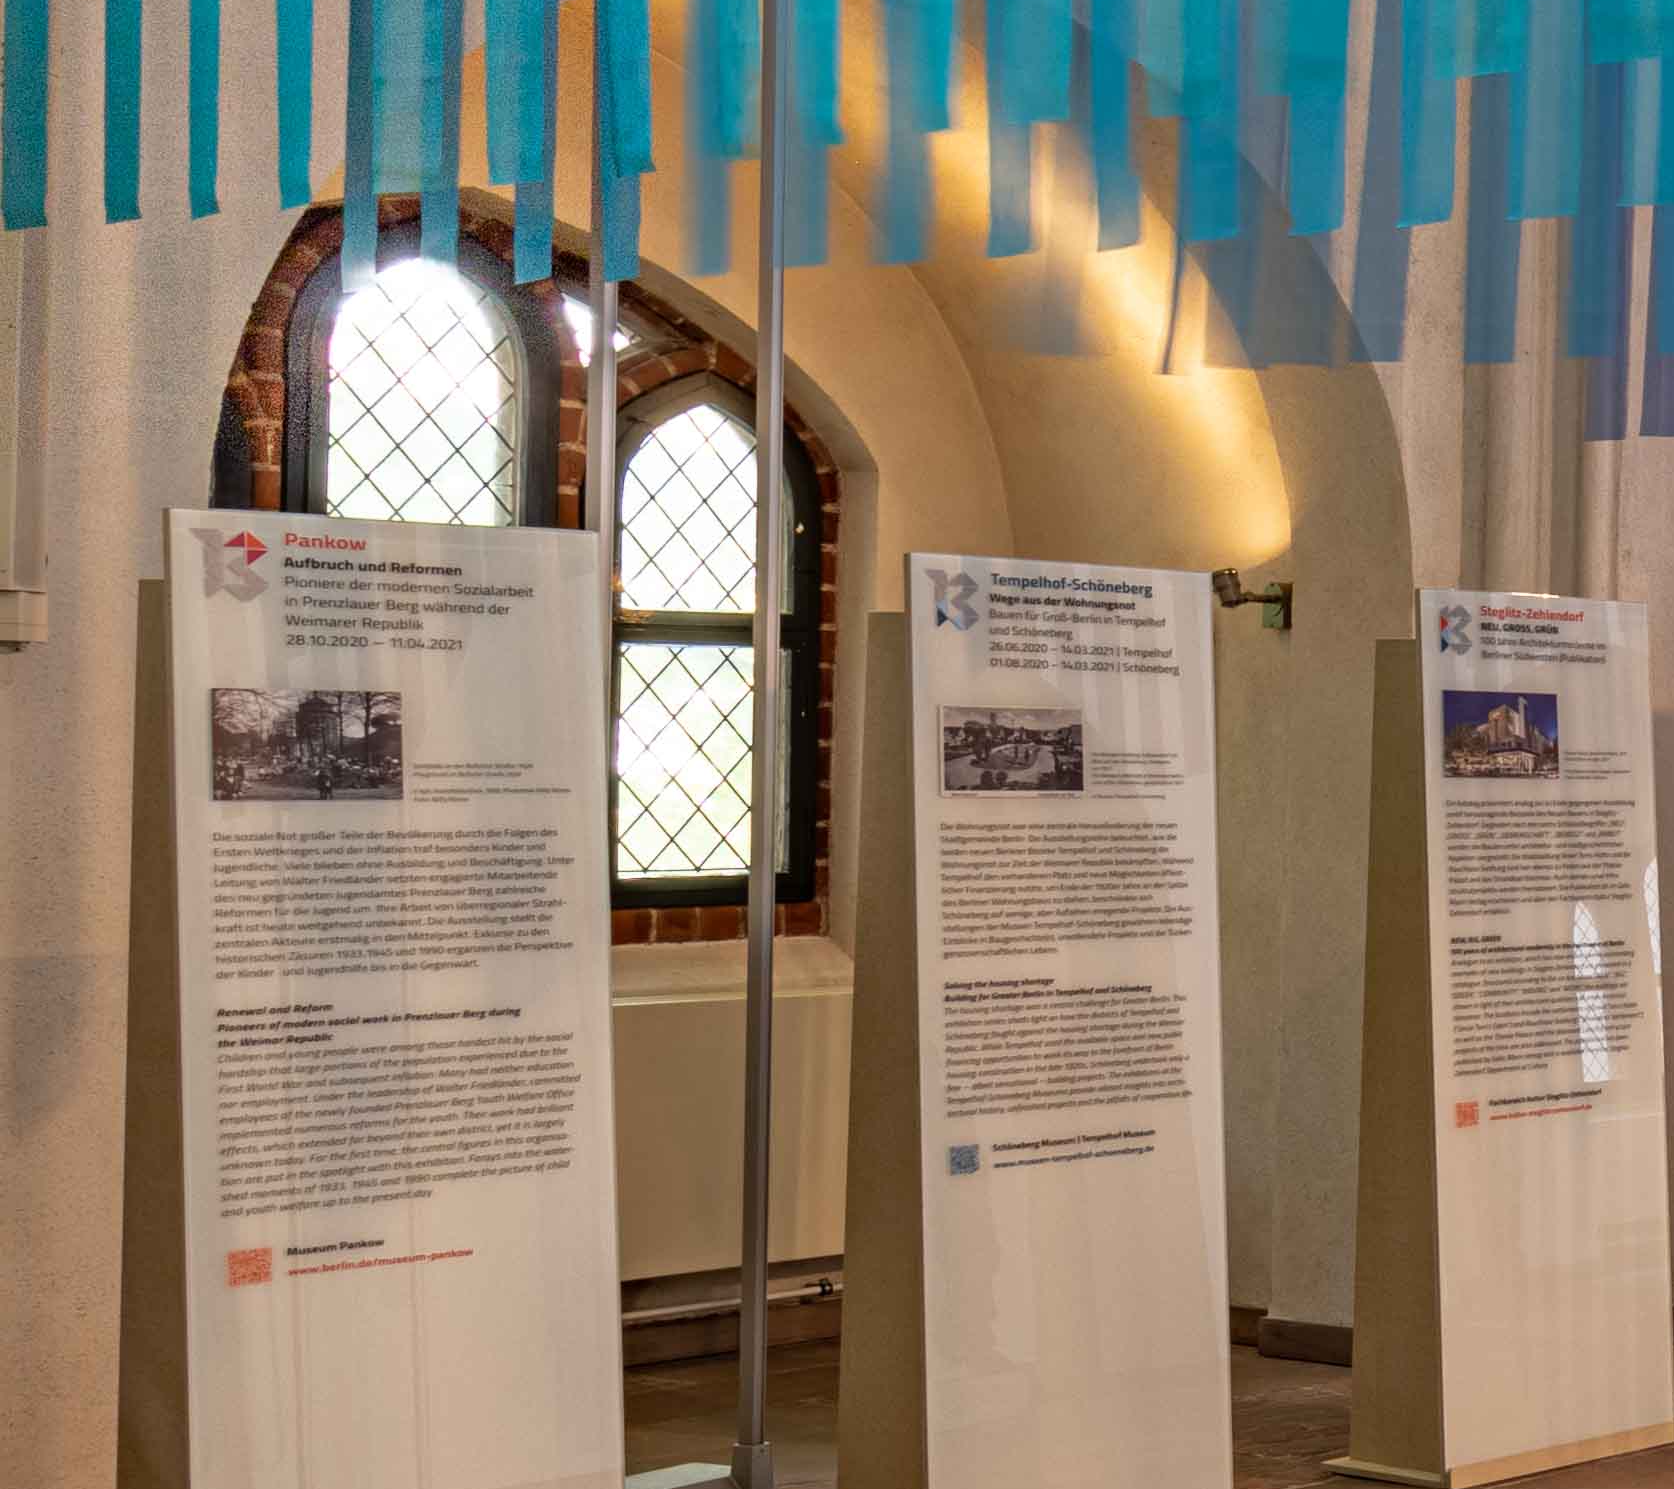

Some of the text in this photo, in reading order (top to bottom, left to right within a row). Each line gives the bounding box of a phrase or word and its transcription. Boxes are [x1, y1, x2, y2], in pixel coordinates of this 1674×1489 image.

[285, 533, 366, 550] Pankow
[284, 557, 462, 576] Aufbruch und Reformen
[284, 576, 533, 597] Pioniere der modernen Sozialarbeit
[991, 573, 1152, 598] Tempelhof-Schöneberg
[285, 596, 511, 615] in Prenzlauer Berg während der
[990, 594, 1020, 605] Wege
[1044, 596, 1061, 605] der
[1064, 598, 1135, 610] Wohnungsnot
[989, 609, 1166, 628] Bauen für Groß-Berlin in Tempelhof
[1481, 606, 1584, 622] Steglitz-Zehlendorf
[285, 616, 424, 631] Weimarer Republik
[989, 626, 1073, 640] und Schöneberg
[286, 635, 368, 647] 28.10.2020
[391, 637, 462, 650] 11.04.2021
[1061, 646, 1113, 656] 14.03.2021
[1122, 648, 1172, 659] Tempelhof
[1061, 662, 1114, 671] 14.03.2021
[1122, 663, 1180, 676] Schöneberg
[217, 1004, 333, 1016] Renewal and Reform
[218, 1008, 521, 1032] Pioneers of modern social work in Prenzlauer Berg during
[218, 1033, 333, 1048] the Weimar Republic
[287, 1239, 384, 1256] Museum Pankow
[288, 1249, 473, 1276] www.berlin.de/museum-pankow
